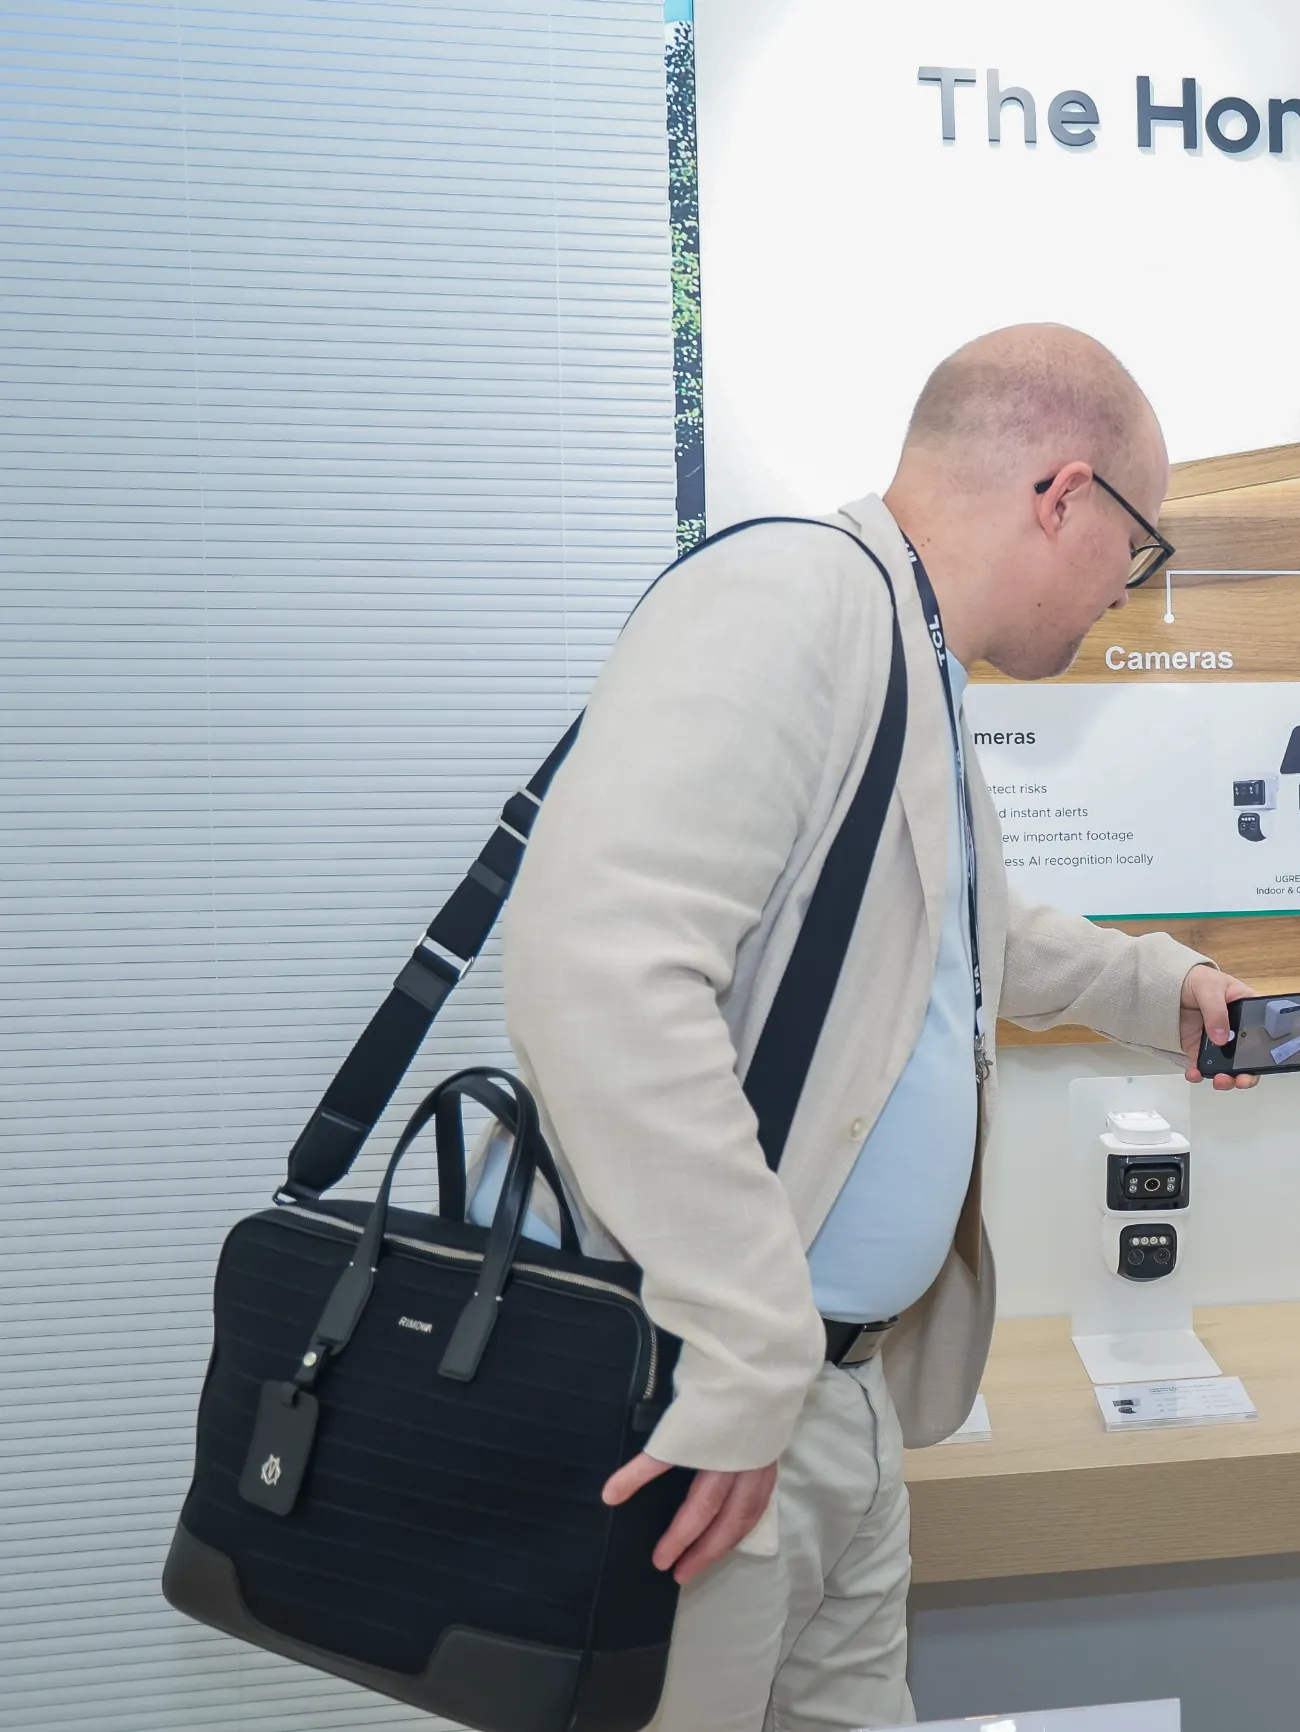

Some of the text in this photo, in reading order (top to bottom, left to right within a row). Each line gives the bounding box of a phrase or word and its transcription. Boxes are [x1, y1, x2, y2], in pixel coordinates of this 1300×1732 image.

[917, 65, 1100, 147] The
[928, 614, 946, 667] TCL
[1104, 645, 1234, 671] Cameras
[972, 730, 1036, 745] meras
[987, 783, 1047, 795] etect risks
[1011, 807, 1051, 818] instant
[1054, 806, 1089, 818] alerts
[1023, 830, 1083, 844] important
[1086, 830, 1134, 842] footage
[1044, 854, 1113, 868] recognition
[1116, 853, 1154, 866] locally
[1256, 886, 1285, 895] Indoor
[1287, 886, 1294, 894] &
